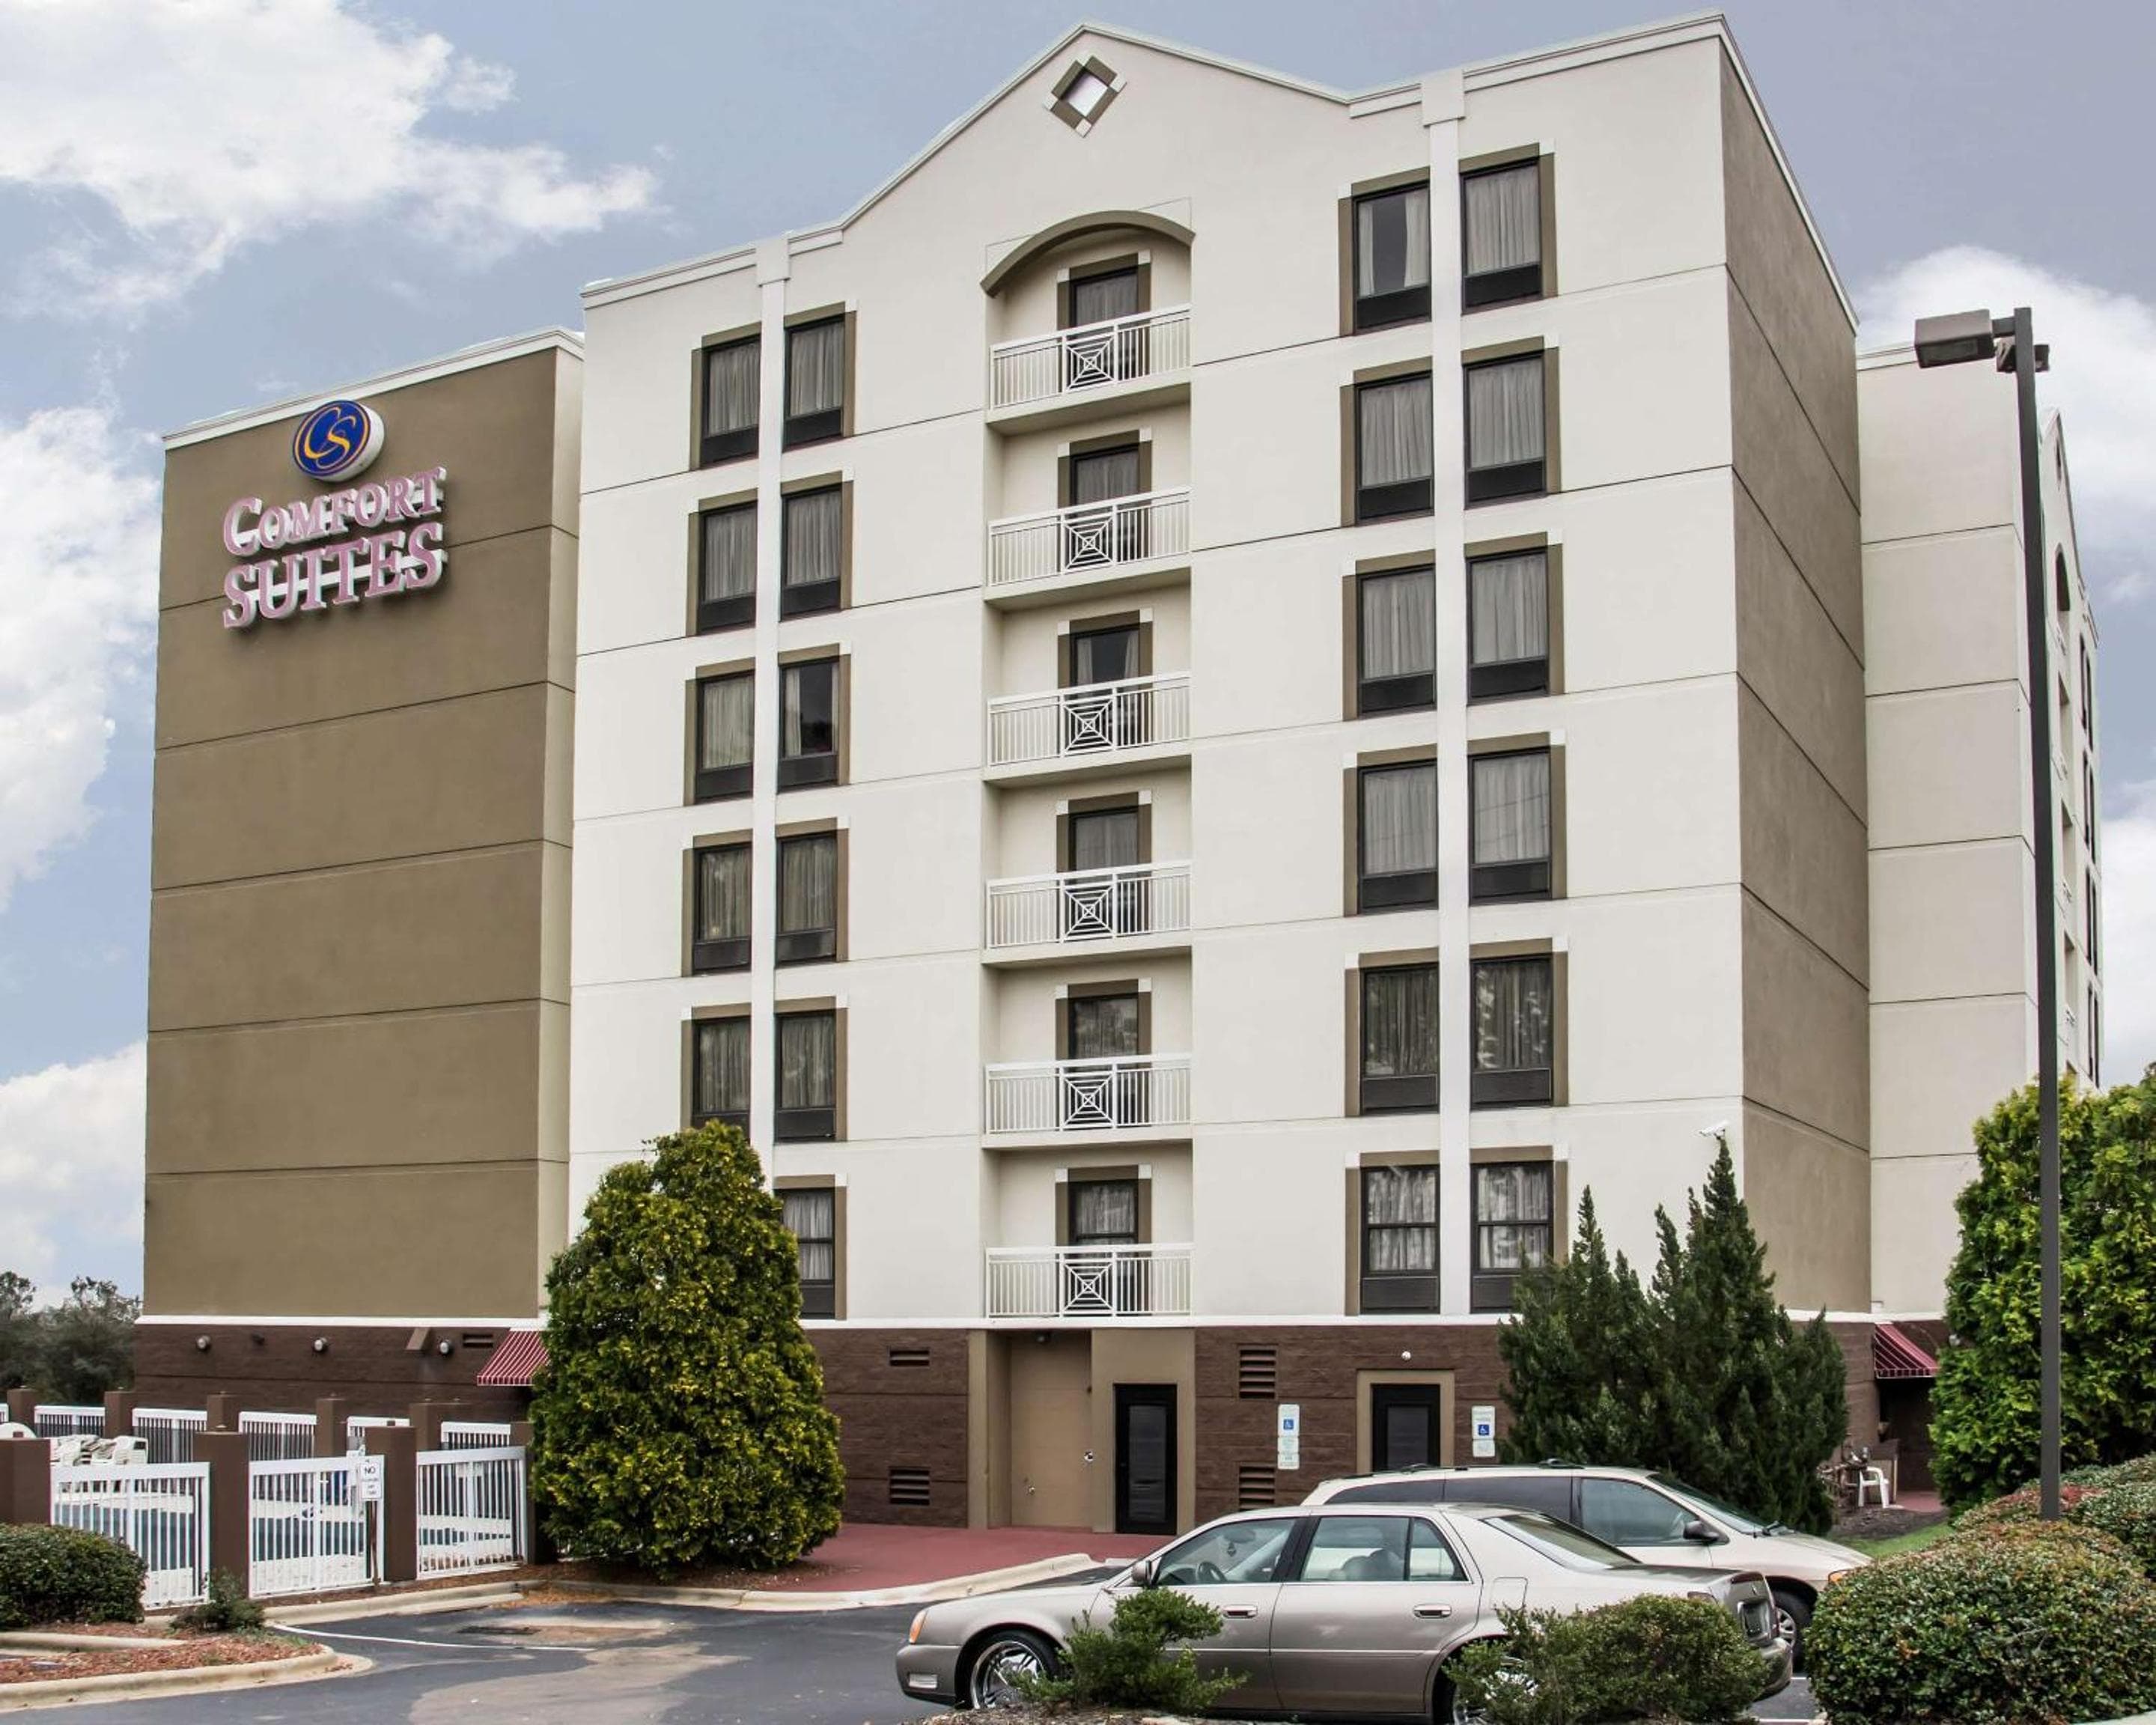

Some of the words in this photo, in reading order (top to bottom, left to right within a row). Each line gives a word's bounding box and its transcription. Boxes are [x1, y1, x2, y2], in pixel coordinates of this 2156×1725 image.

[223, 466, 447, 557] COMFORT
[223, 521, 447, 628] SUITES
[364, 1466, 376, 1476] NO
